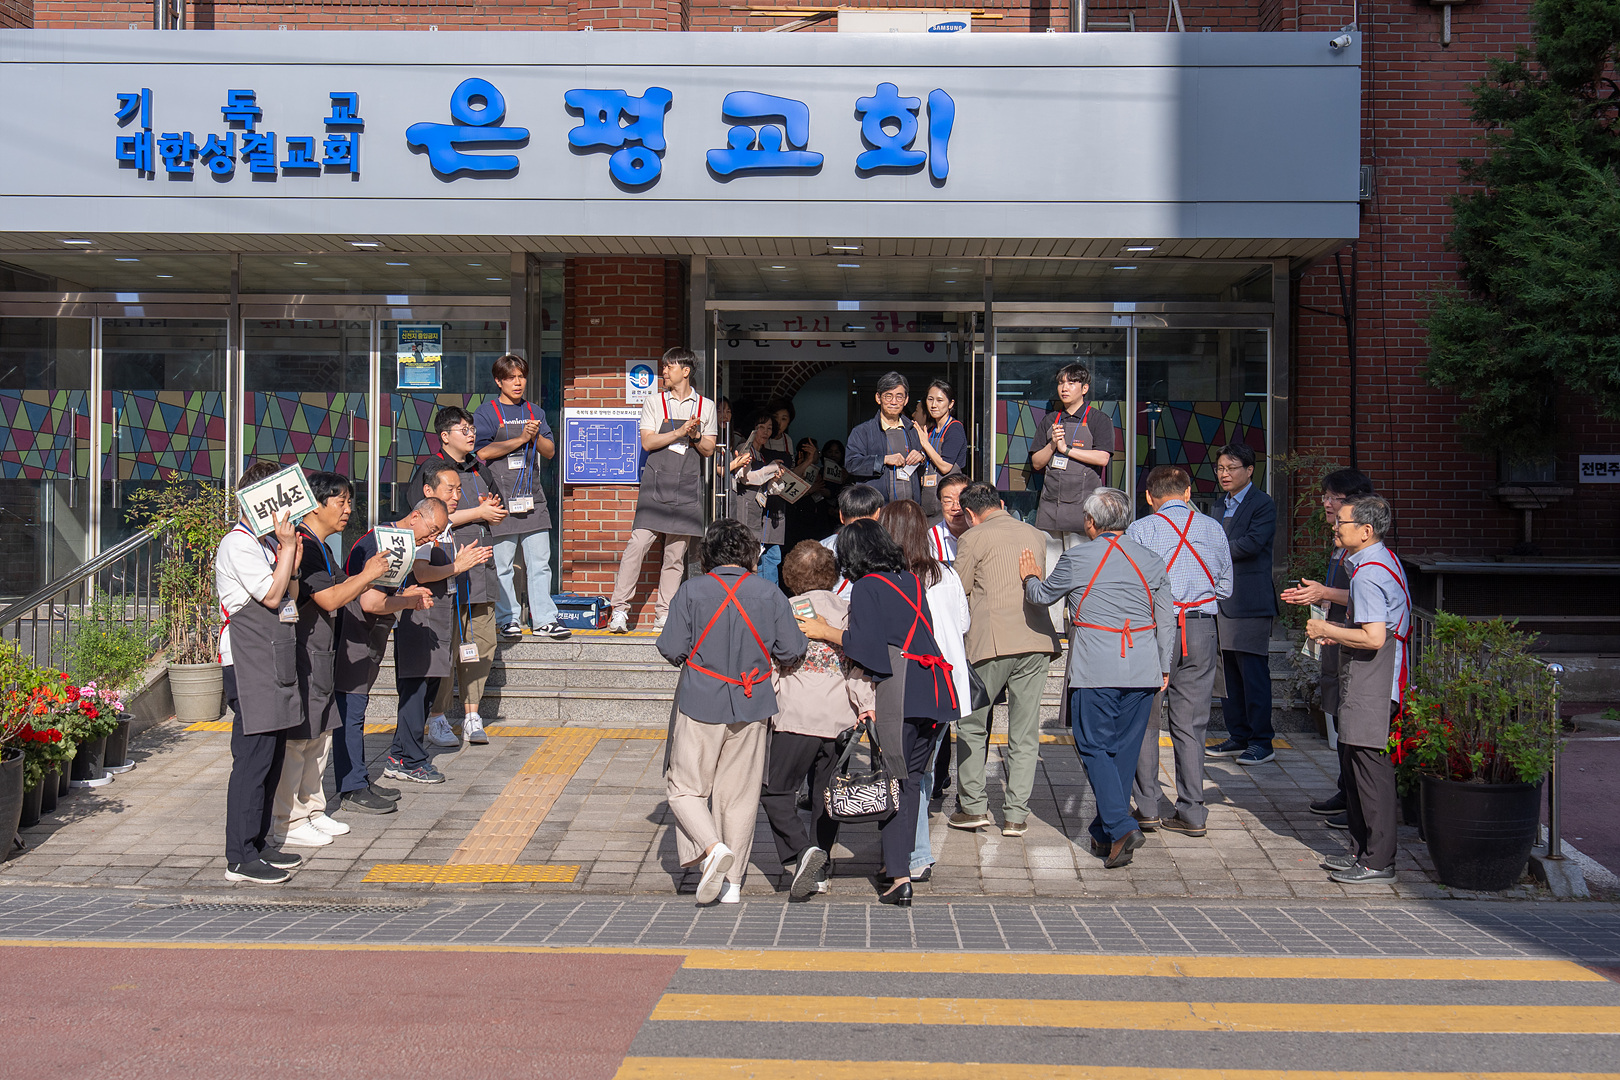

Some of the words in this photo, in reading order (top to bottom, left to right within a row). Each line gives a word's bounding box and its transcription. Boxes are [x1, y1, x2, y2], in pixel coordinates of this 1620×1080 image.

[405, 77, 955, 188] 은평교회
[115, 131, 360, 180] 대한성결교회
[1582, 462, 1620, 476] 전면주
[253, 483, 305, 520] 남자4조
[556, 612, 580, 620] 켓프레시
